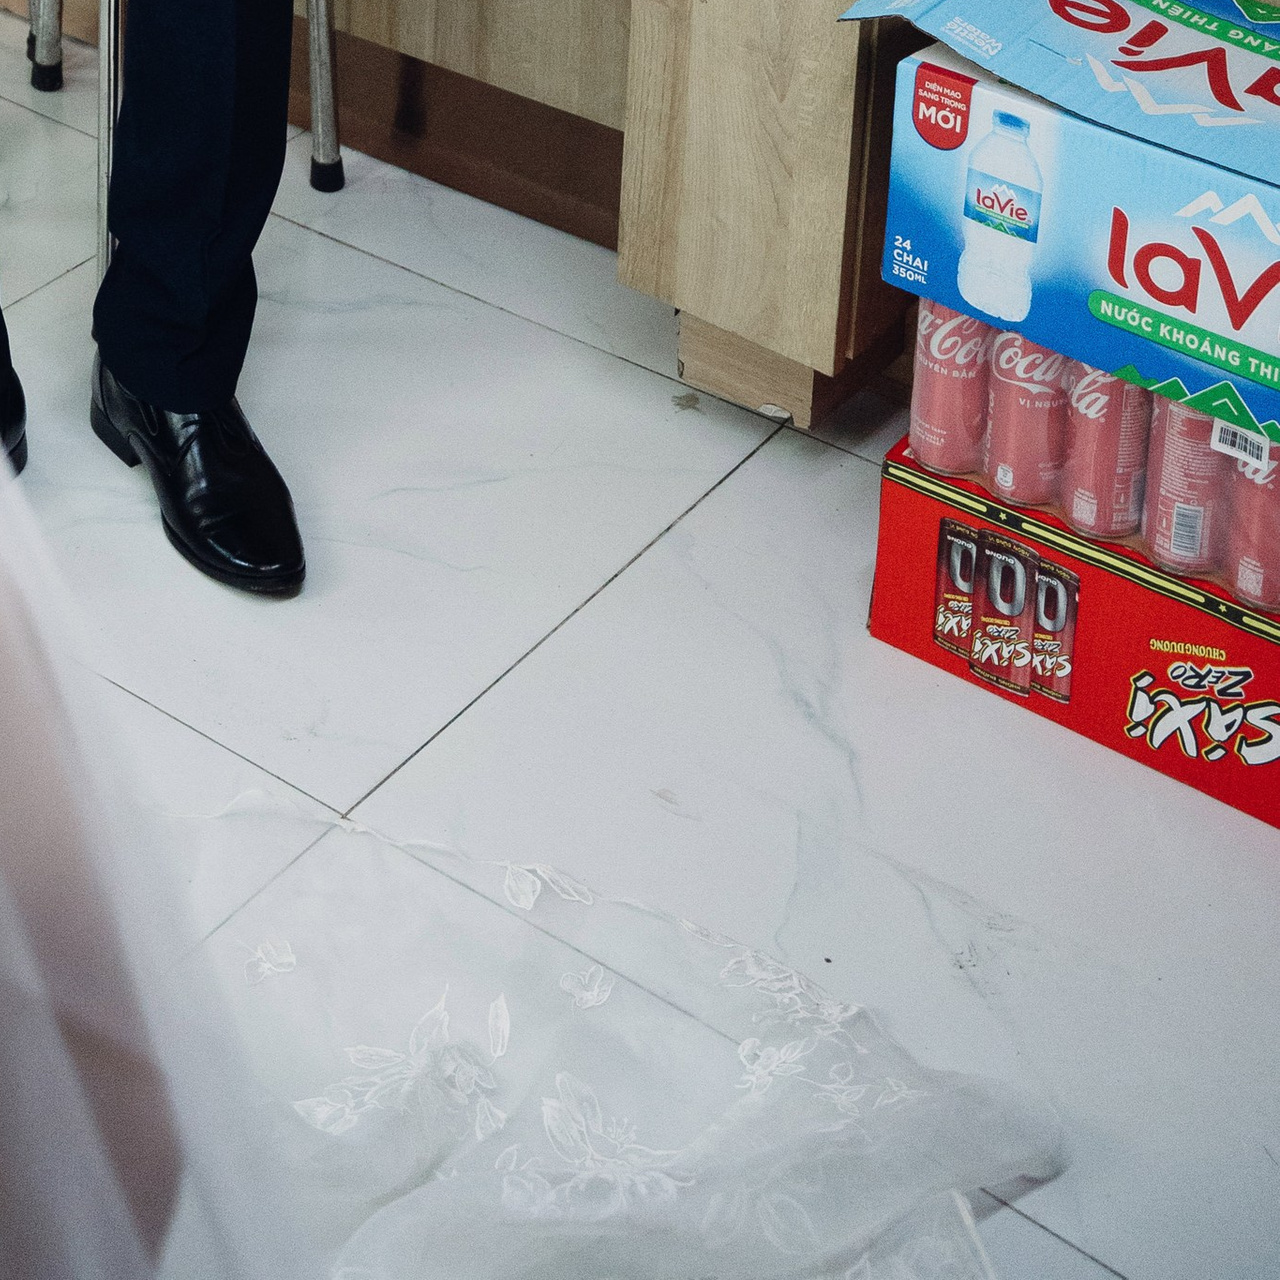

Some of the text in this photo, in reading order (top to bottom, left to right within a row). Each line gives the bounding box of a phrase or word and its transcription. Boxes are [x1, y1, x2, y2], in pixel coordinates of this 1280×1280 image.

[918, 88, 967, 111] SANG TRỌNG
[925, 81, 962, 99] DIỆN MẠO
[918, 101, 962, 133] MỚI
[976, 187, 1028, 221] laVie
[894, 235, 912, 251] 24
[893, 249, 928, 271] CHAI
[1107, 206, 1280, 331] laV
[892, 263, 927, 285] 350ML
[1100, 299, 1280, 382] NƯỚC KHOÁNG THI
[986, 624, 1020, 640] ZERO
[1167, 661, 1255, 699] ZERO
